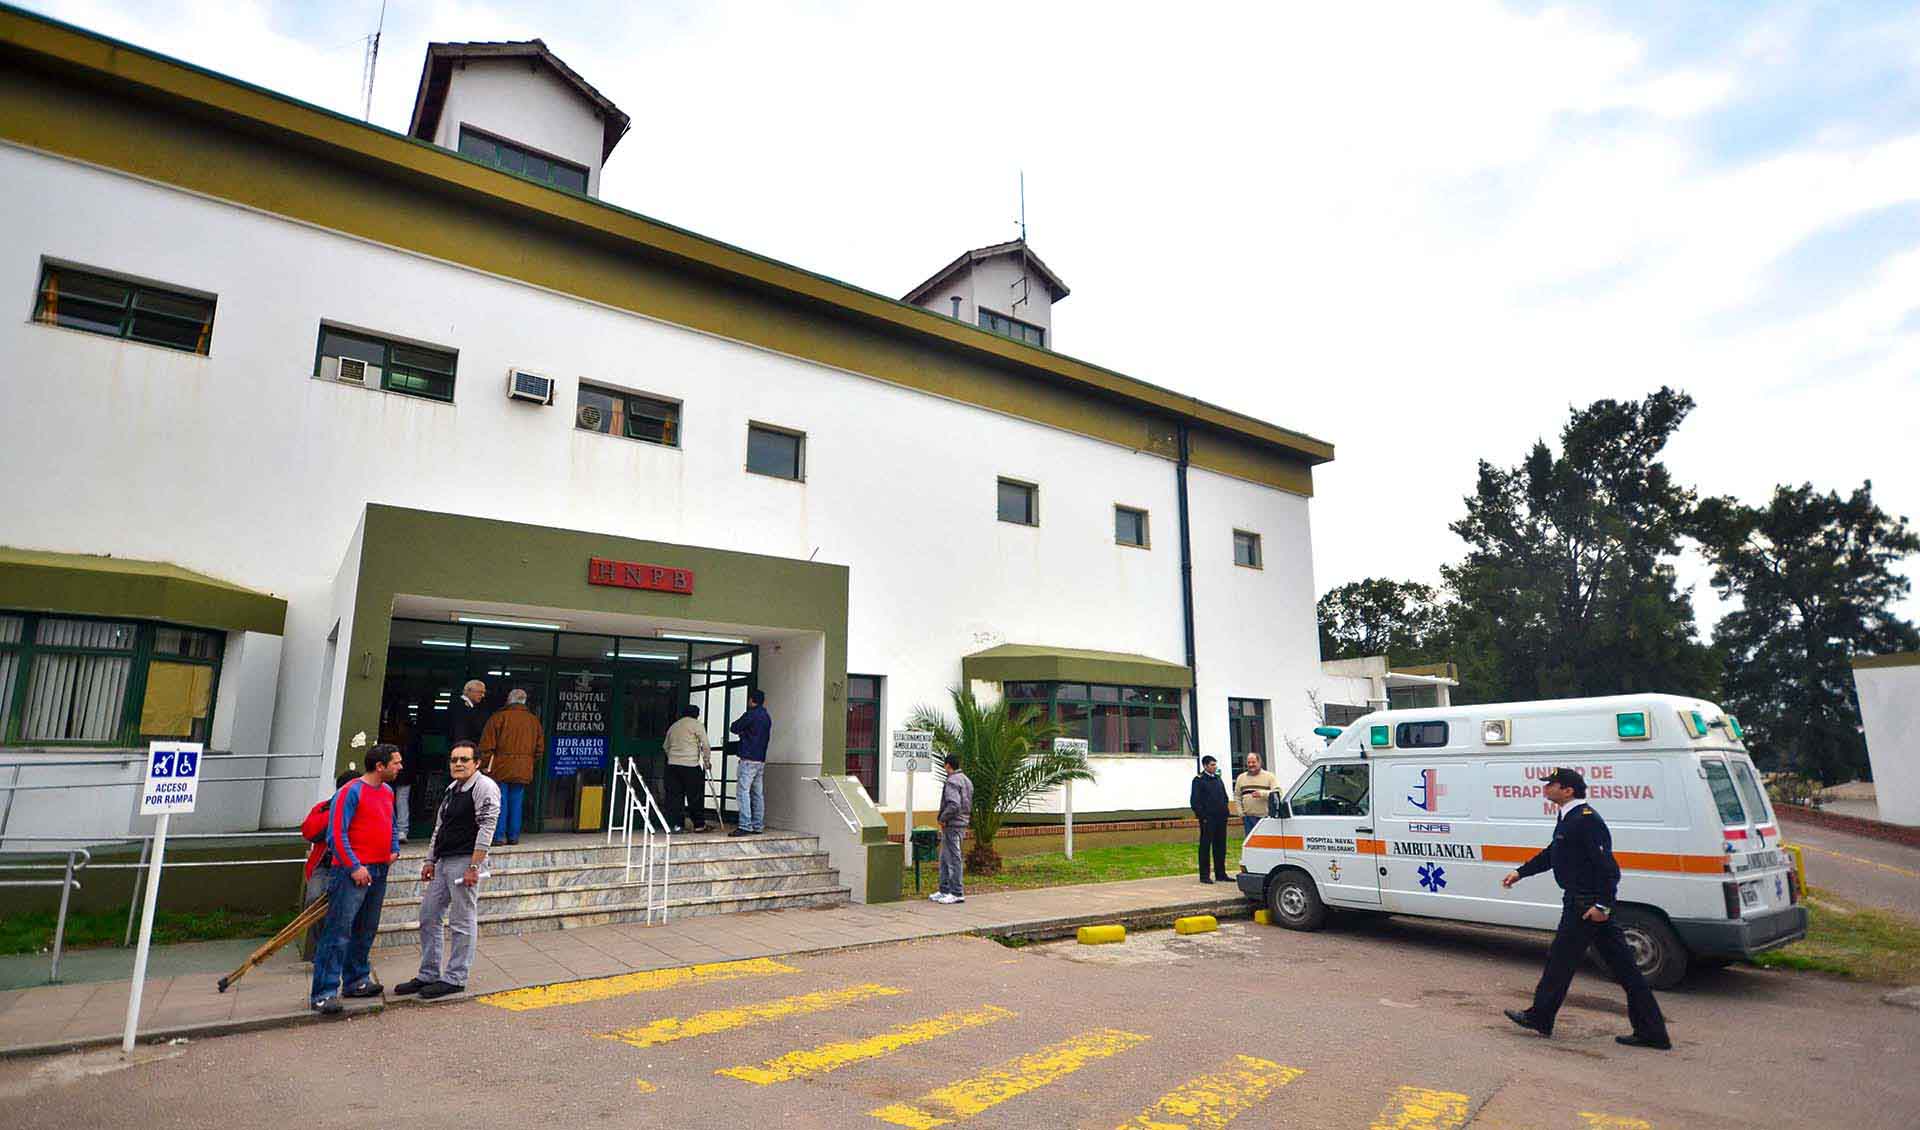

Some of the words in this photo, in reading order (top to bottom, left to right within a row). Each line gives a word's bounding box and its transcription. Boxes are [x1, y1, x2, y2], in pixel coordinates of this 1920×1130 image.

[598, 559, 687, 588] HNPB
[559, 691, 606, 702] HOSPITAL
[565, 702, 599, 711] NAVAL
[561, 711, 602, 721] PUERTO
[556, 721, 605, 731] BELGRANO
[557, 738, 603, 747] HORARIO
[556, 747, 568, 756] DE
[570, 747, 604, 756] VISITAS
[1591, 766, 1613, 779] DE
[155, 783, 187, 792] ACCESO
[145, 795, 163, 805] POR
[164, 794, 193, 804] RAMPA
[1408, 823, 1451, 833] HNPB
[1306, 836, 1333, 844] HOSPITAL
[1393, 841, 1475, 859] AMBULANCIA
